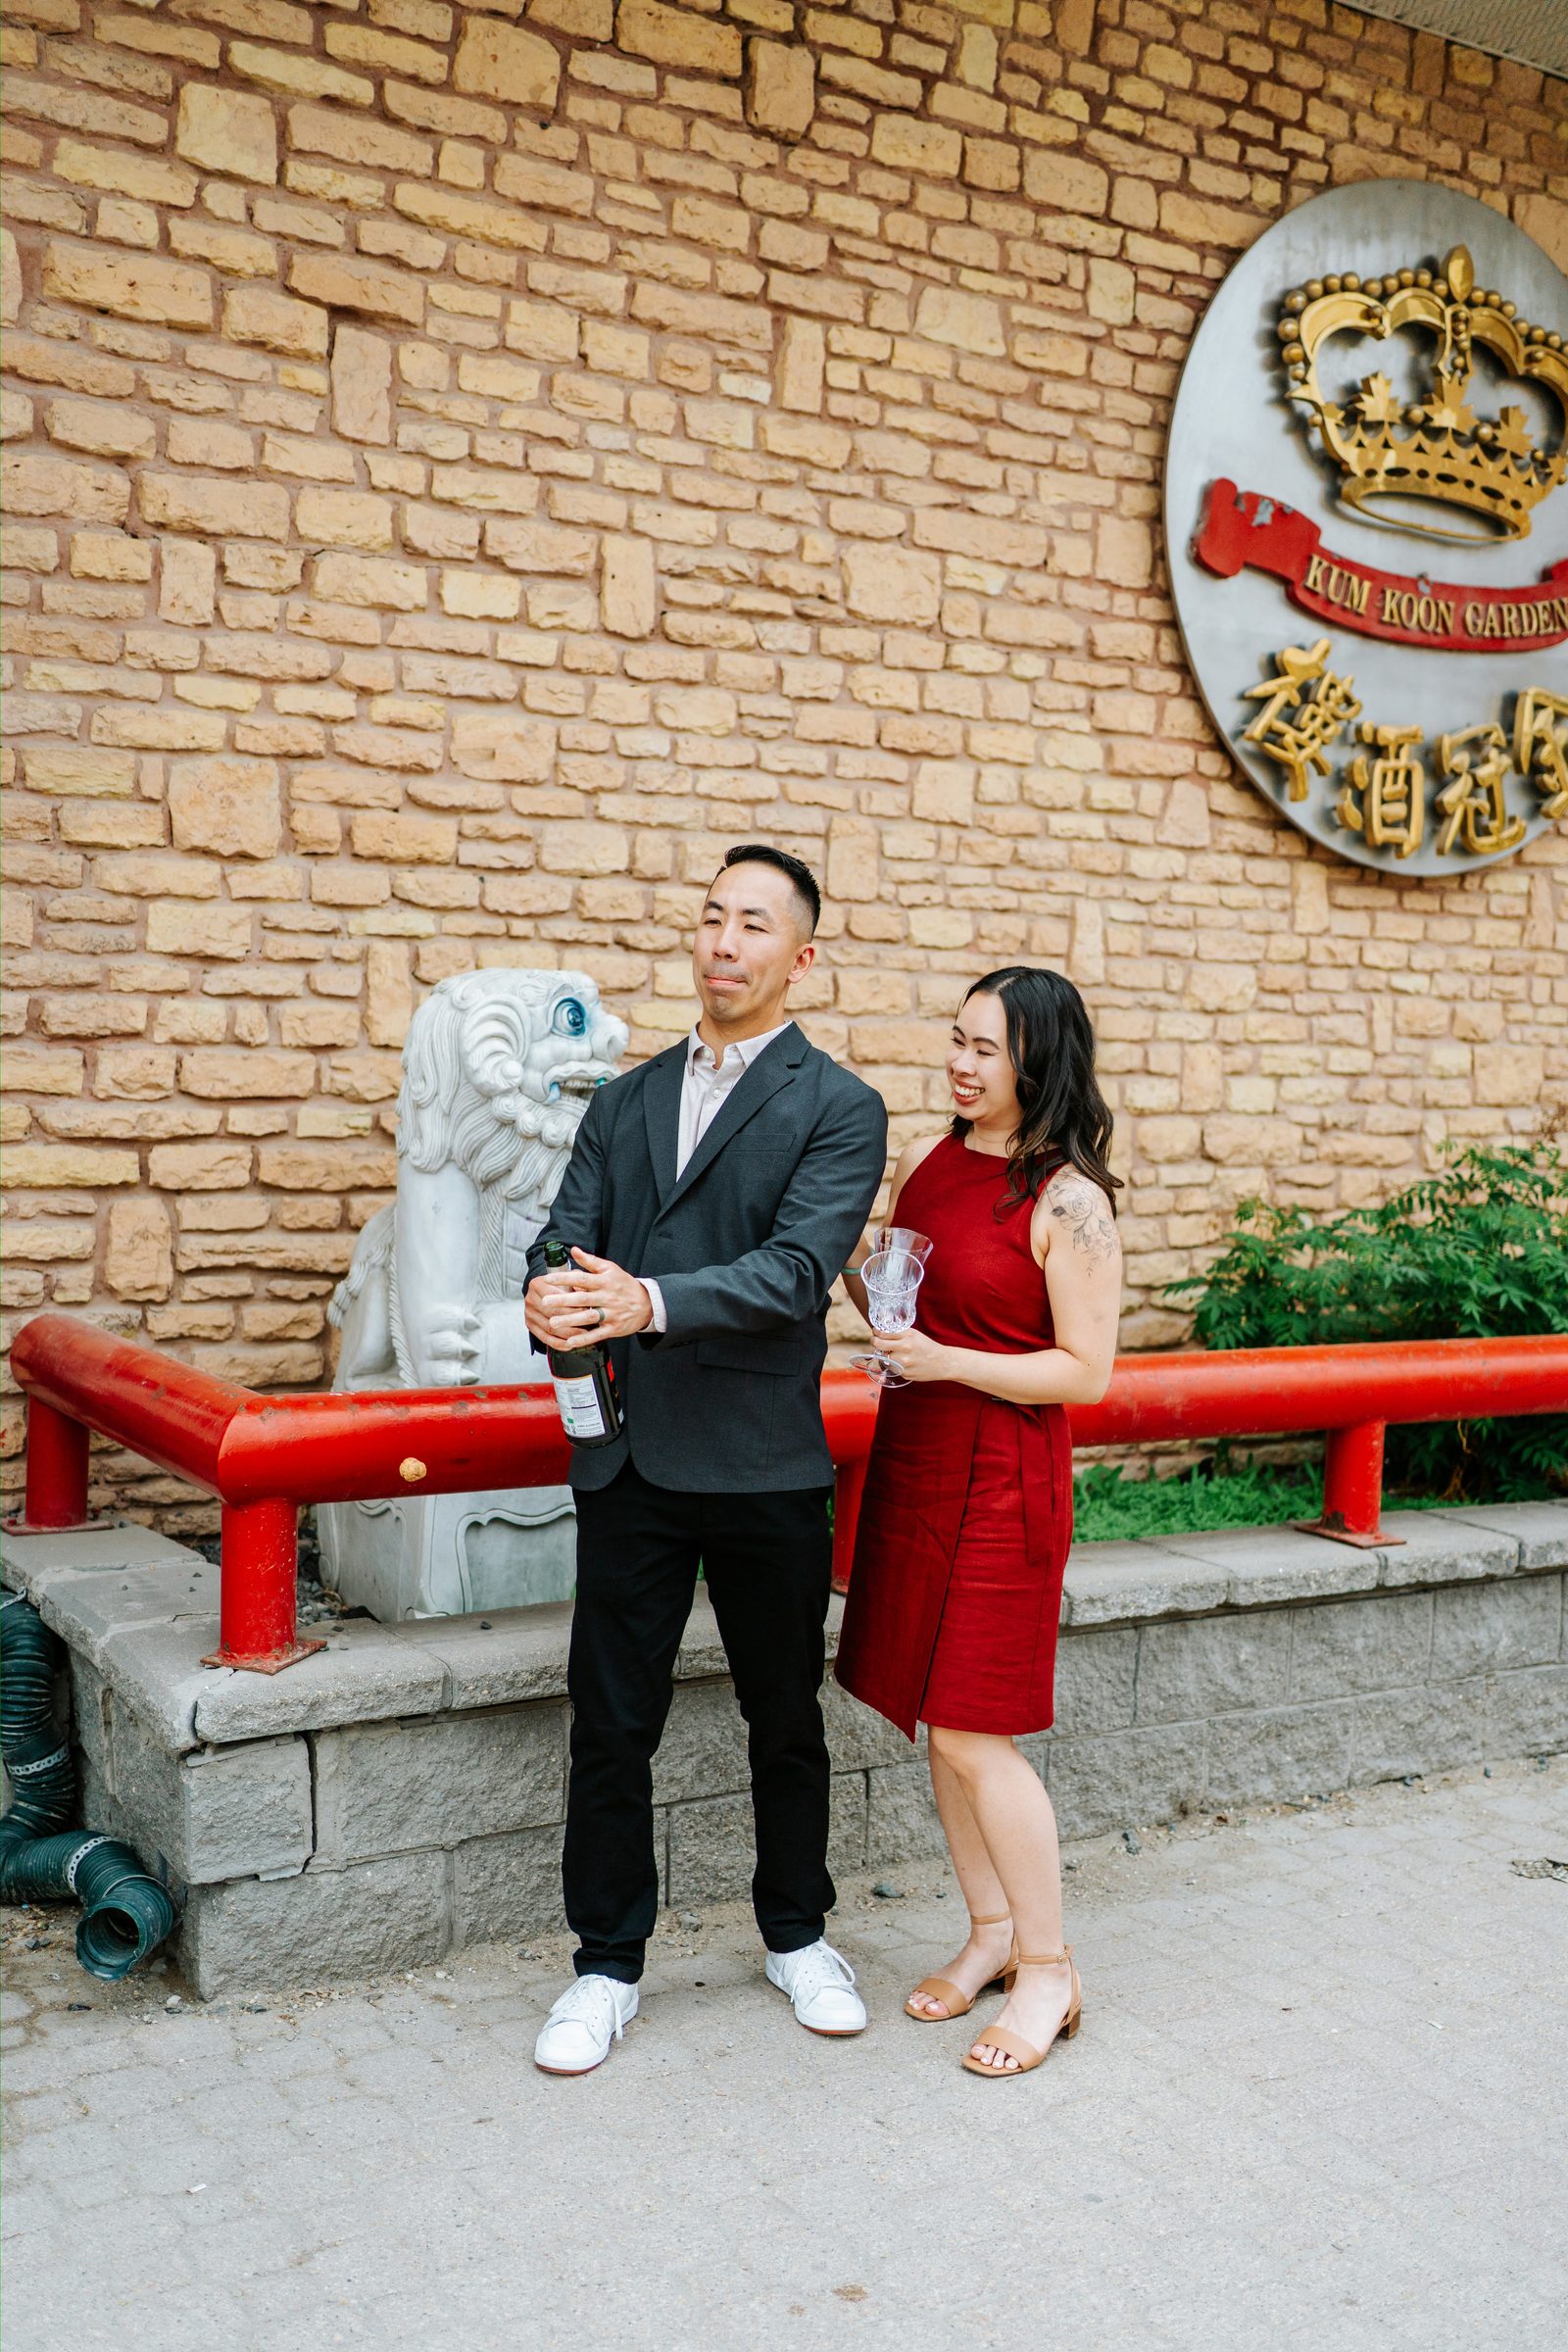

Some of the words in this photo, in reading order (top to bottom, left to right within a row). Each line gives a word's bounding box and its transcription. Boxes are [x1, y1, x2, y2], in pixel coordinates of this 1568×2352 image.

[1305, 554, 1372, 614] KUM
[1382, 587, 1455, 635] KOON
[1465, 597, 1568, 638] GARDEN
